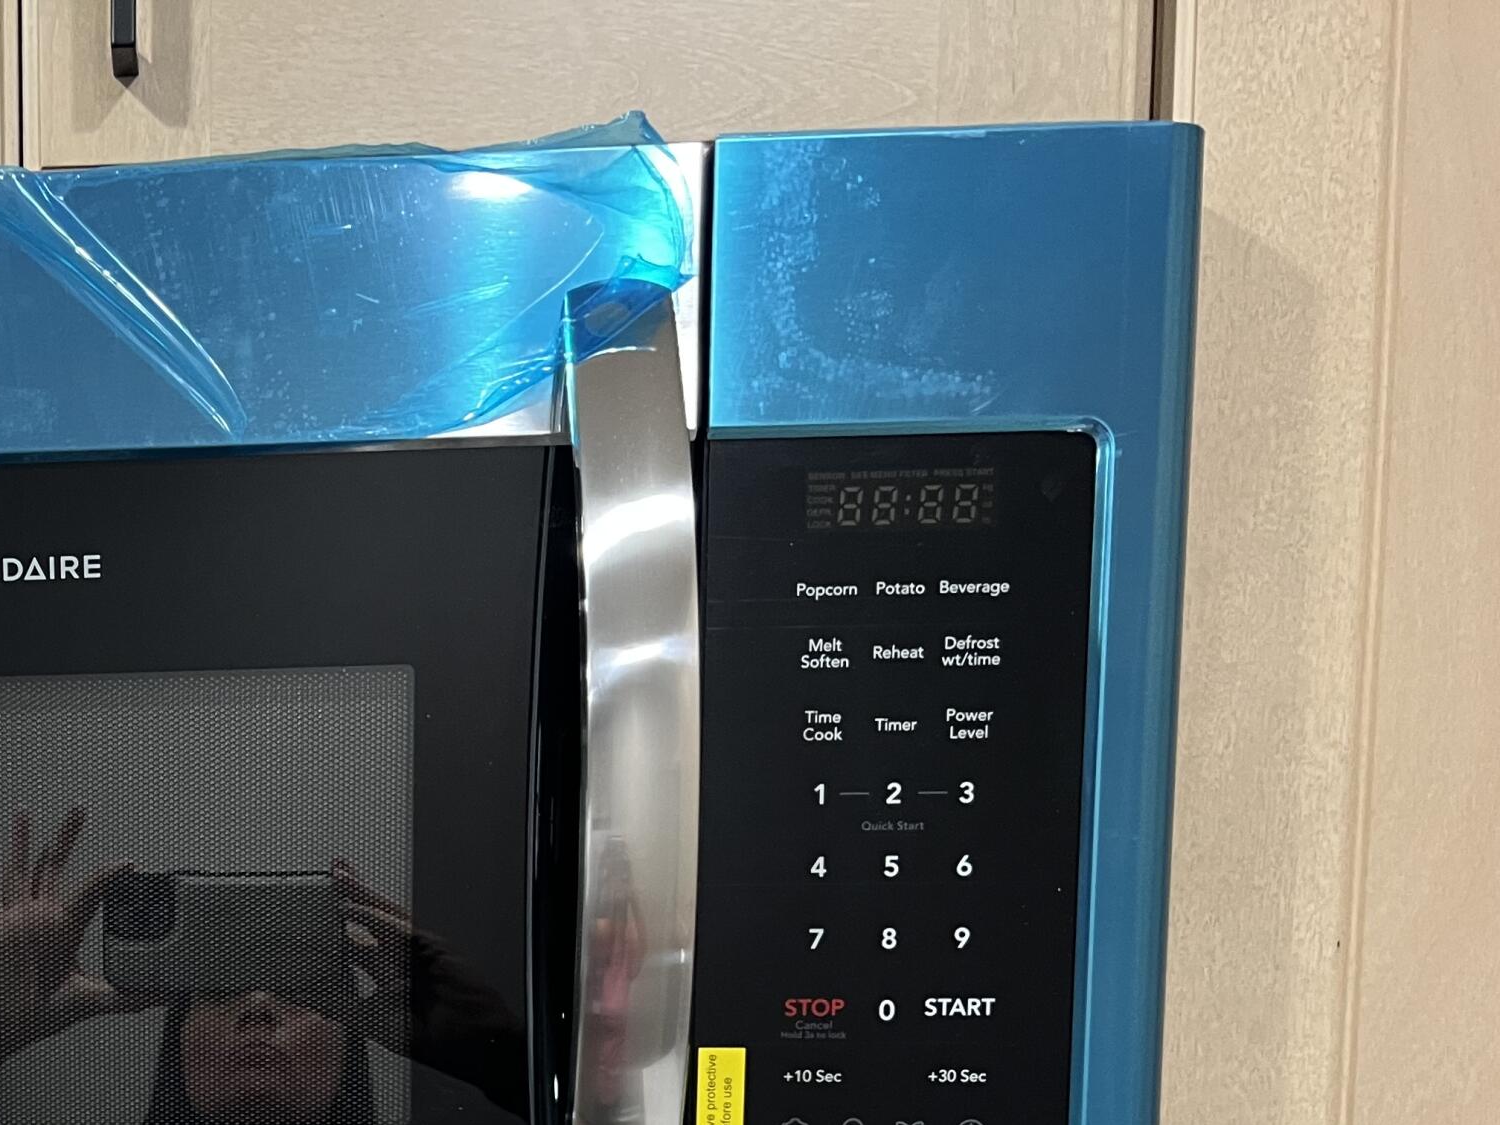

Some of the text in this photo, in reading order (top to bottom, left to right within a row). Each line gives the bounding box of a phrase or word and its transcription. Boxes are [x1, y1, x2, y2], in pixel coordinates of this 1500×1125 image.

[796, 583, 858, 600] Popcorn
[876, 582, 925, 595] Potato
[939, 580, 1010, 596] Beverage
[808, 638, 842, 653] Melt
[944, 635, 1000, 650] Defrost
[873, 645, 924, 659] Reheat
[942, 653, 1001, 667] wt/time
[801, 654, 849, 669] Soften
[805, 710, 841, 724] Time
[946, 709, 994, 723] Power
[875, 718, 917, 731] Timer
[950, 725, 988, 739] Level
[803, 727, 842, 741] Cook
[813, 784, 825, 805] 1
[886, 783, 901, 804] 2
[959, 782, 975, 803] 3
[862, 821, 924, 833] Quick Start
[810, 857, 827, 877] 4
[884, 856, 899, 877] 5
[956, 855, 973, 876] 6
[809, 929, 824, 949] 7
[881, 928, 897, 949] 8
[954, 928, 971, 949] 9
[784, 999, 844, 1017] STOP
[879, 1000, 895, 1021] 0
[924, 998, 995, 1016] START
[796, 1021, 832, 1030] Cancel
[705, 1054, 718, 1111] protective
[783, 1070, 842, 1082] +10 Sec
[928, 1070, 987, 1082] +30 Sec
[722, 1077, 733, 1098] use
